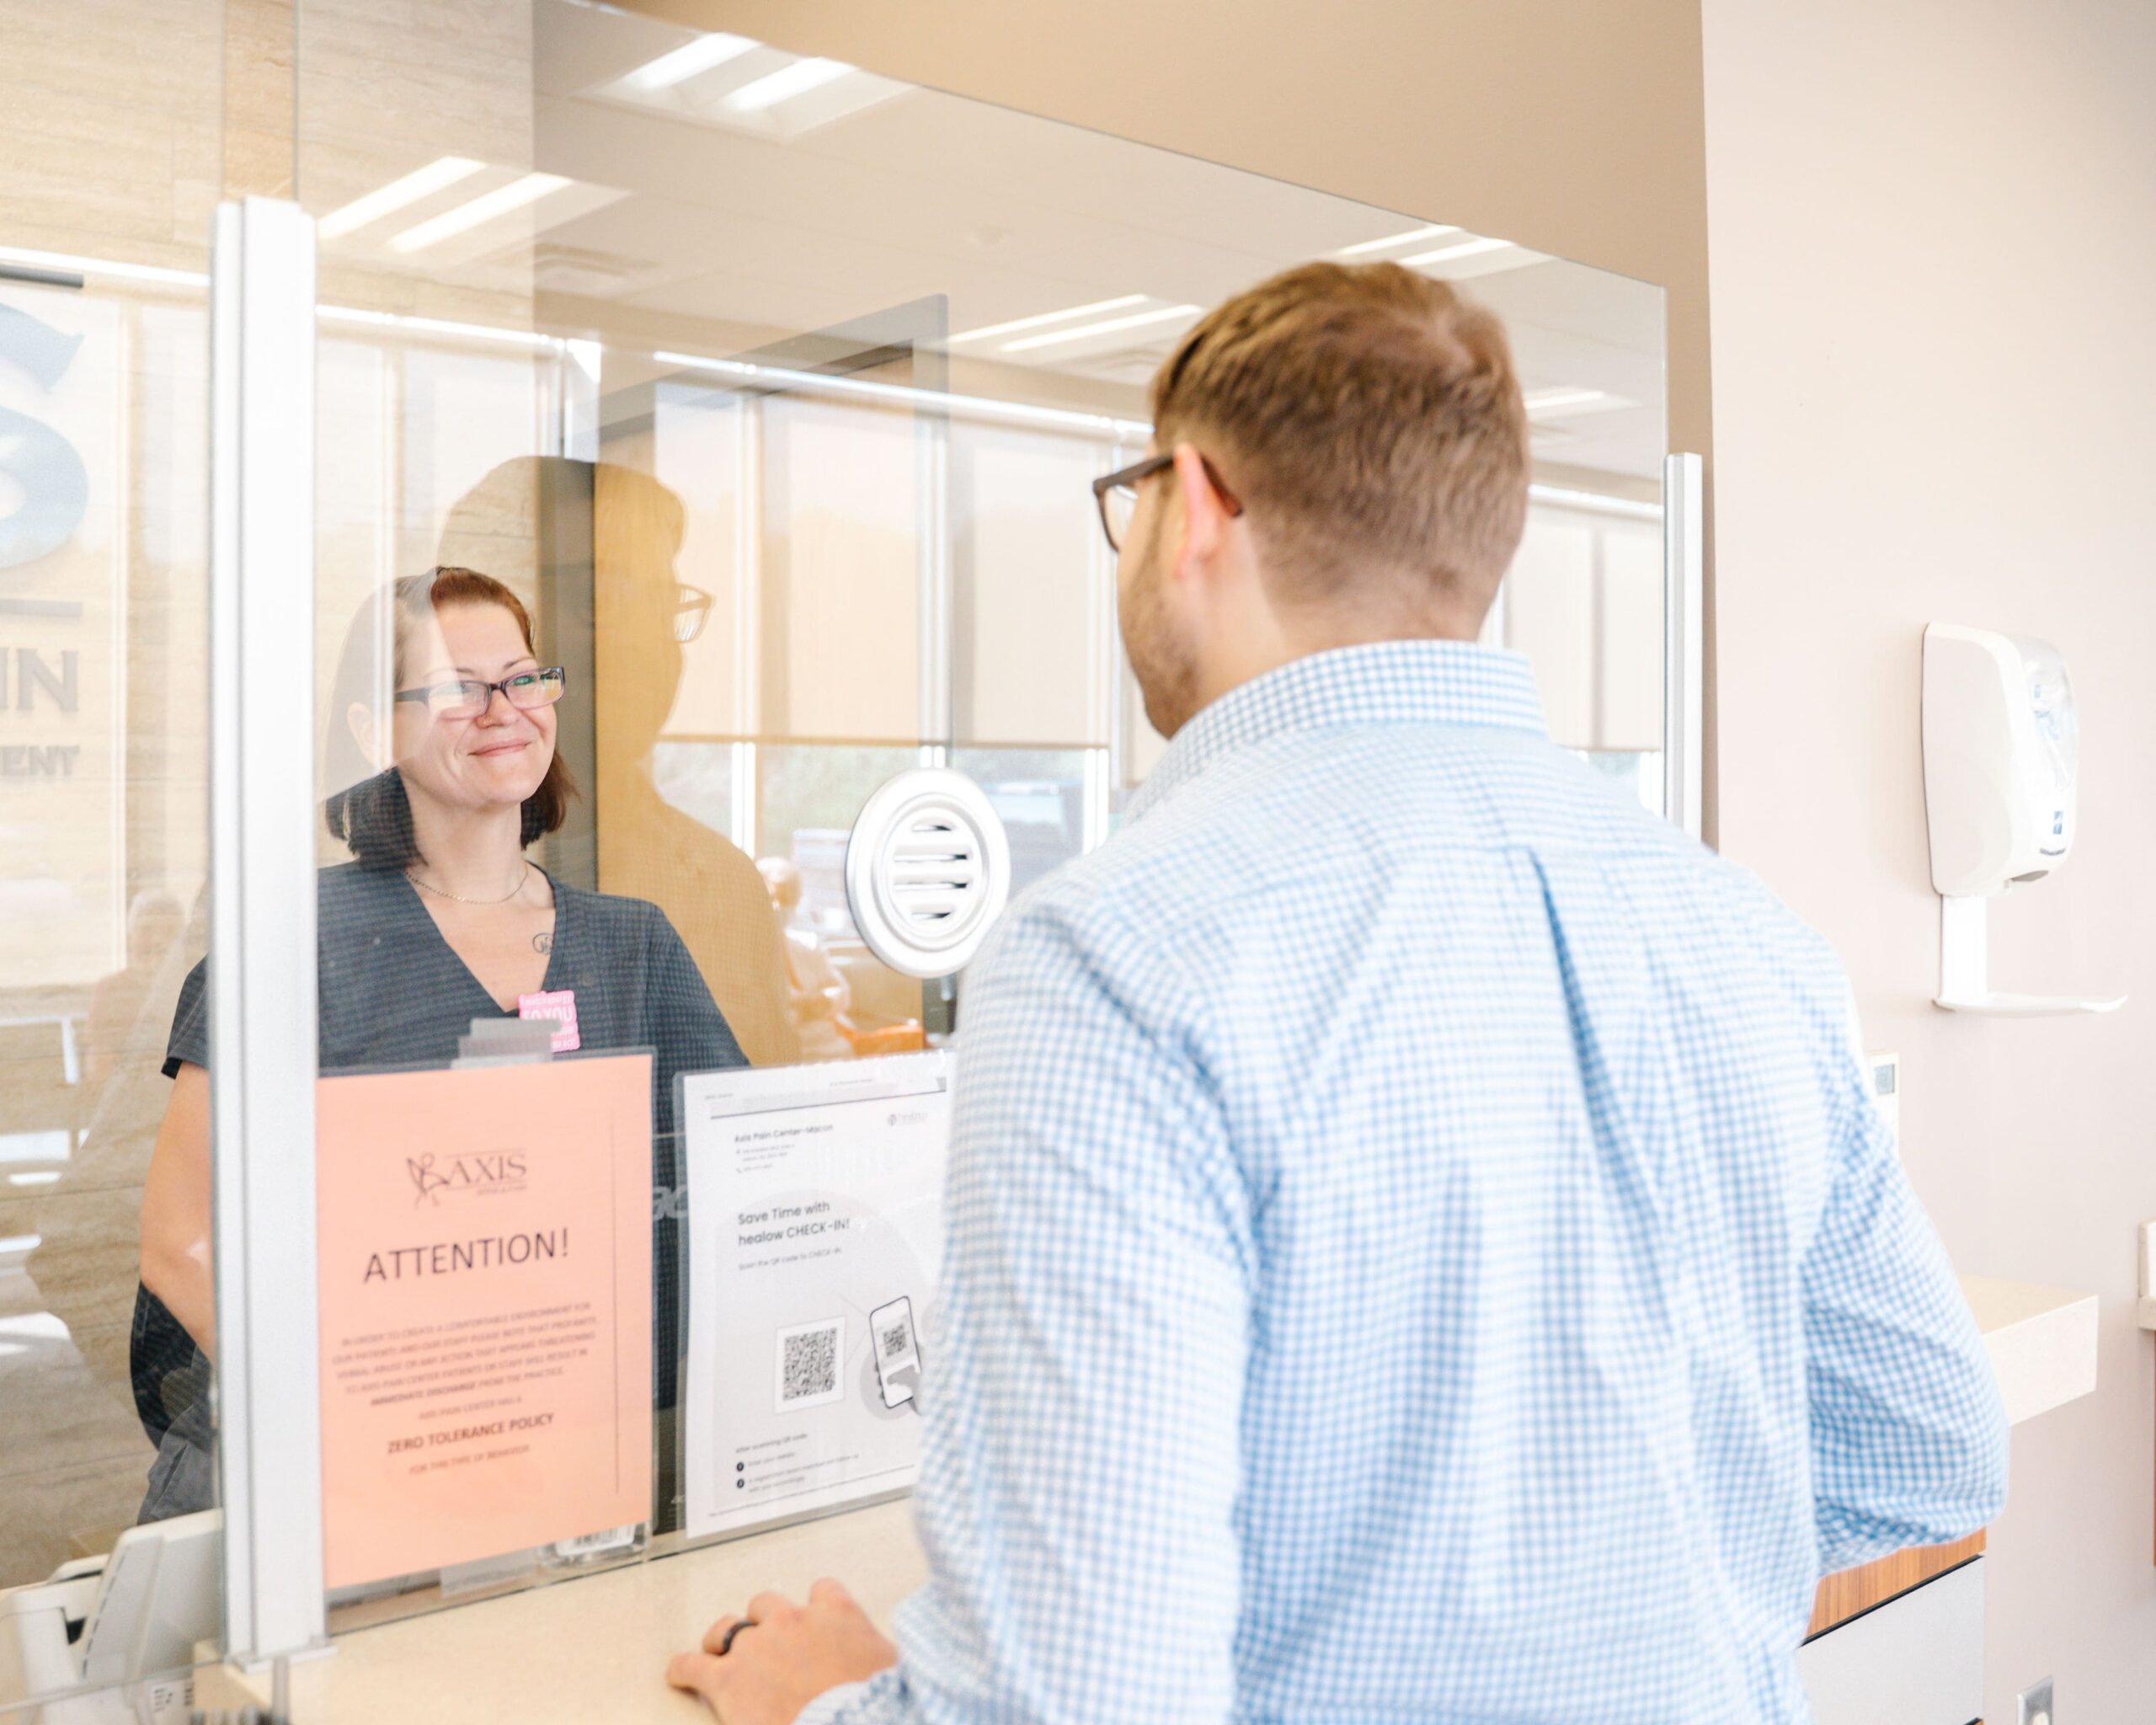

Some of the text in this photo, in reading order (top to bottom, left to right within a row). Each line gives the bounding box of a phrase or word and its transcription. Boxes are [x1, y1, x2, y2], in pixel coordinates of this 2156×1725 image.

[542, 1006, 573, 1023] YOU
[445, 1154, 527, 1186] AXIS
[738, 1200, 830, 1226] Save Time with
[739, 1219, 850, 1246] healow CHECK-IN!
[363, 1227, 569, 1284] ATTENTION!
[387, 1412, 553, 1455] ZERO TOLERANCE POLICY
